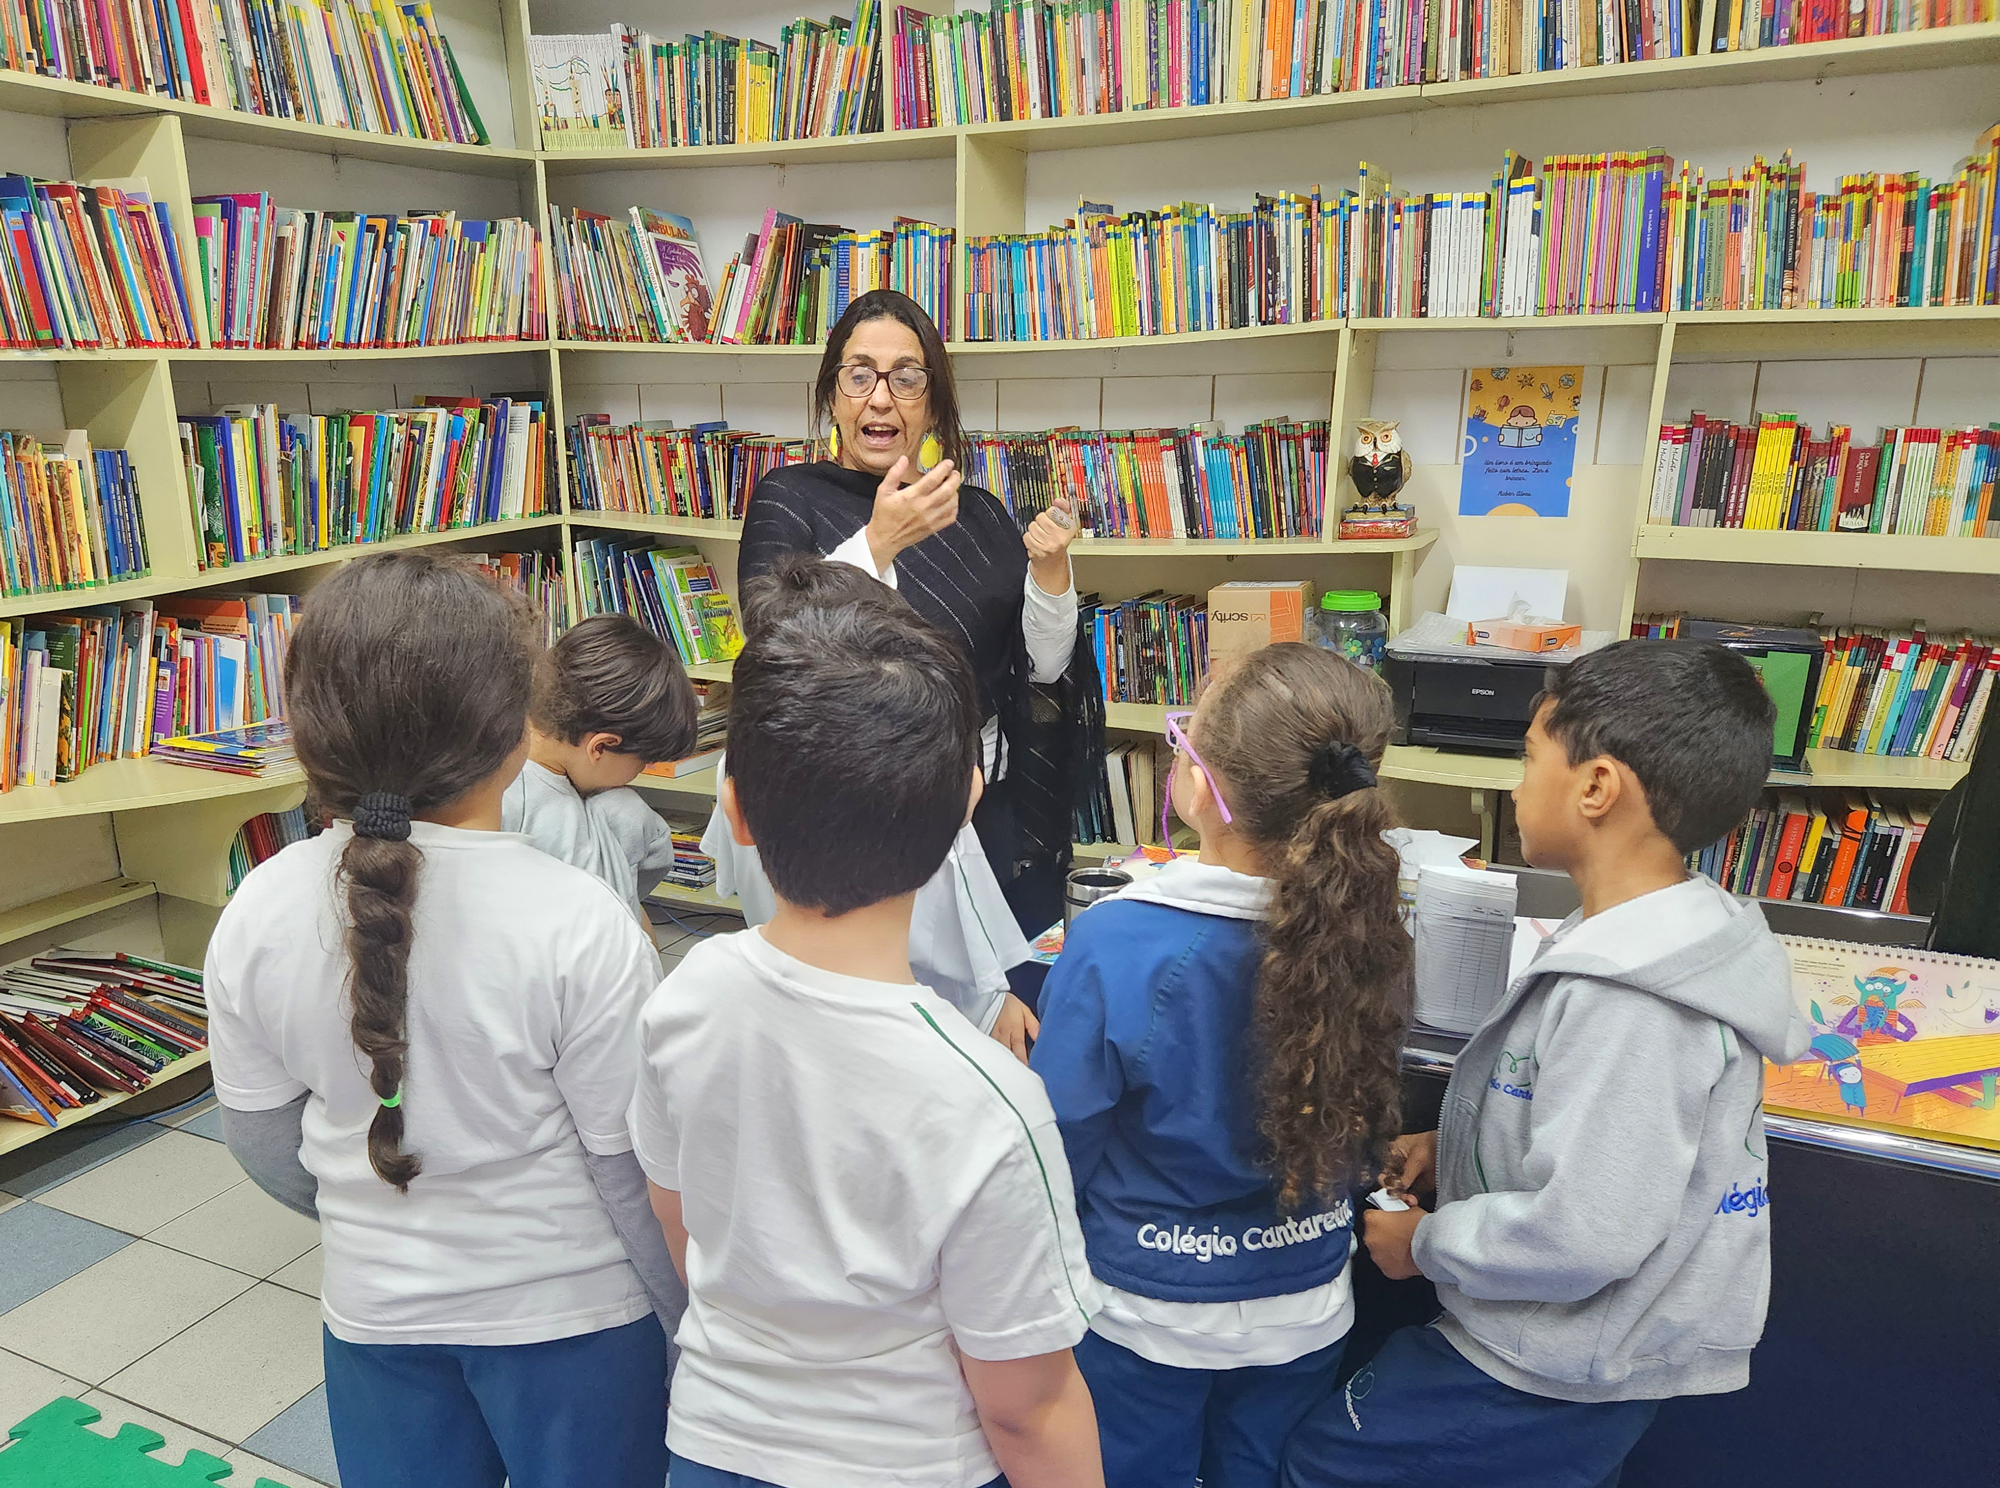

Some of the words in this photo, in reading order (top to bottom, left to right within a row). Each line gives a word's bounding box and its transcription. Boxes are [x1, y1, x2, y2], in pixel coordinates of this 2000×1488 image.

[646, 262, 659, 293] FAVORITAS
[1854, 452, 1865, 494] MOSQUETEIROS
[1471, 688, 1495, 696] EPSON
[1775, 874, 1785, 897] CÍRCULO
[1785, 846, 1793, 860] DAVE
[1789, 823, 1799, 844] EGGERS
[1137, 1222, 1238, 1264] Colégio
